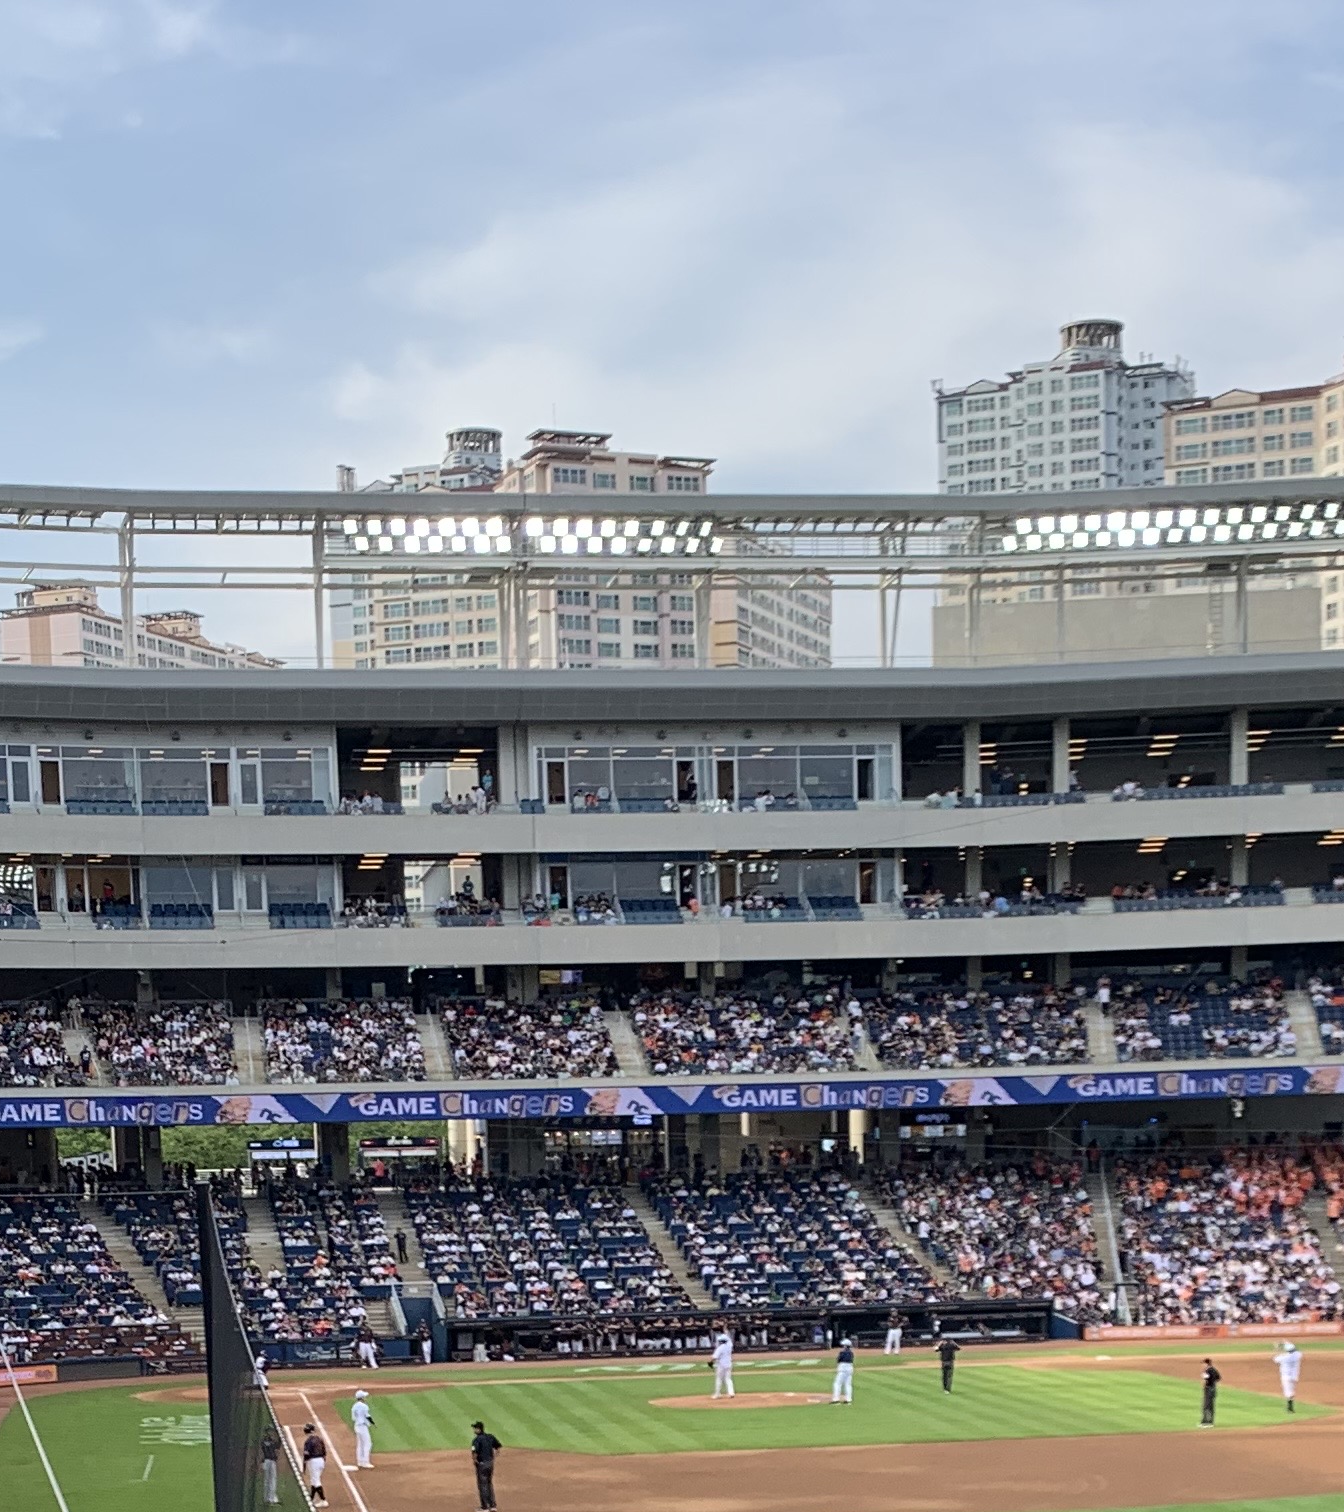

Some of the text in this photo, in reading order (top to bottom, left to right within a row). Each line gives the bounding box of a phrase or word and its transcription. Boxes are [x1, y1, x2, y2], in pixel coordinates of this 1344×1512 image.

[720, 1086, 798, 1108] GAME
[1076, 1074, 1155, 1099] GAME
[359, 1097, 436, 1116] GAME
